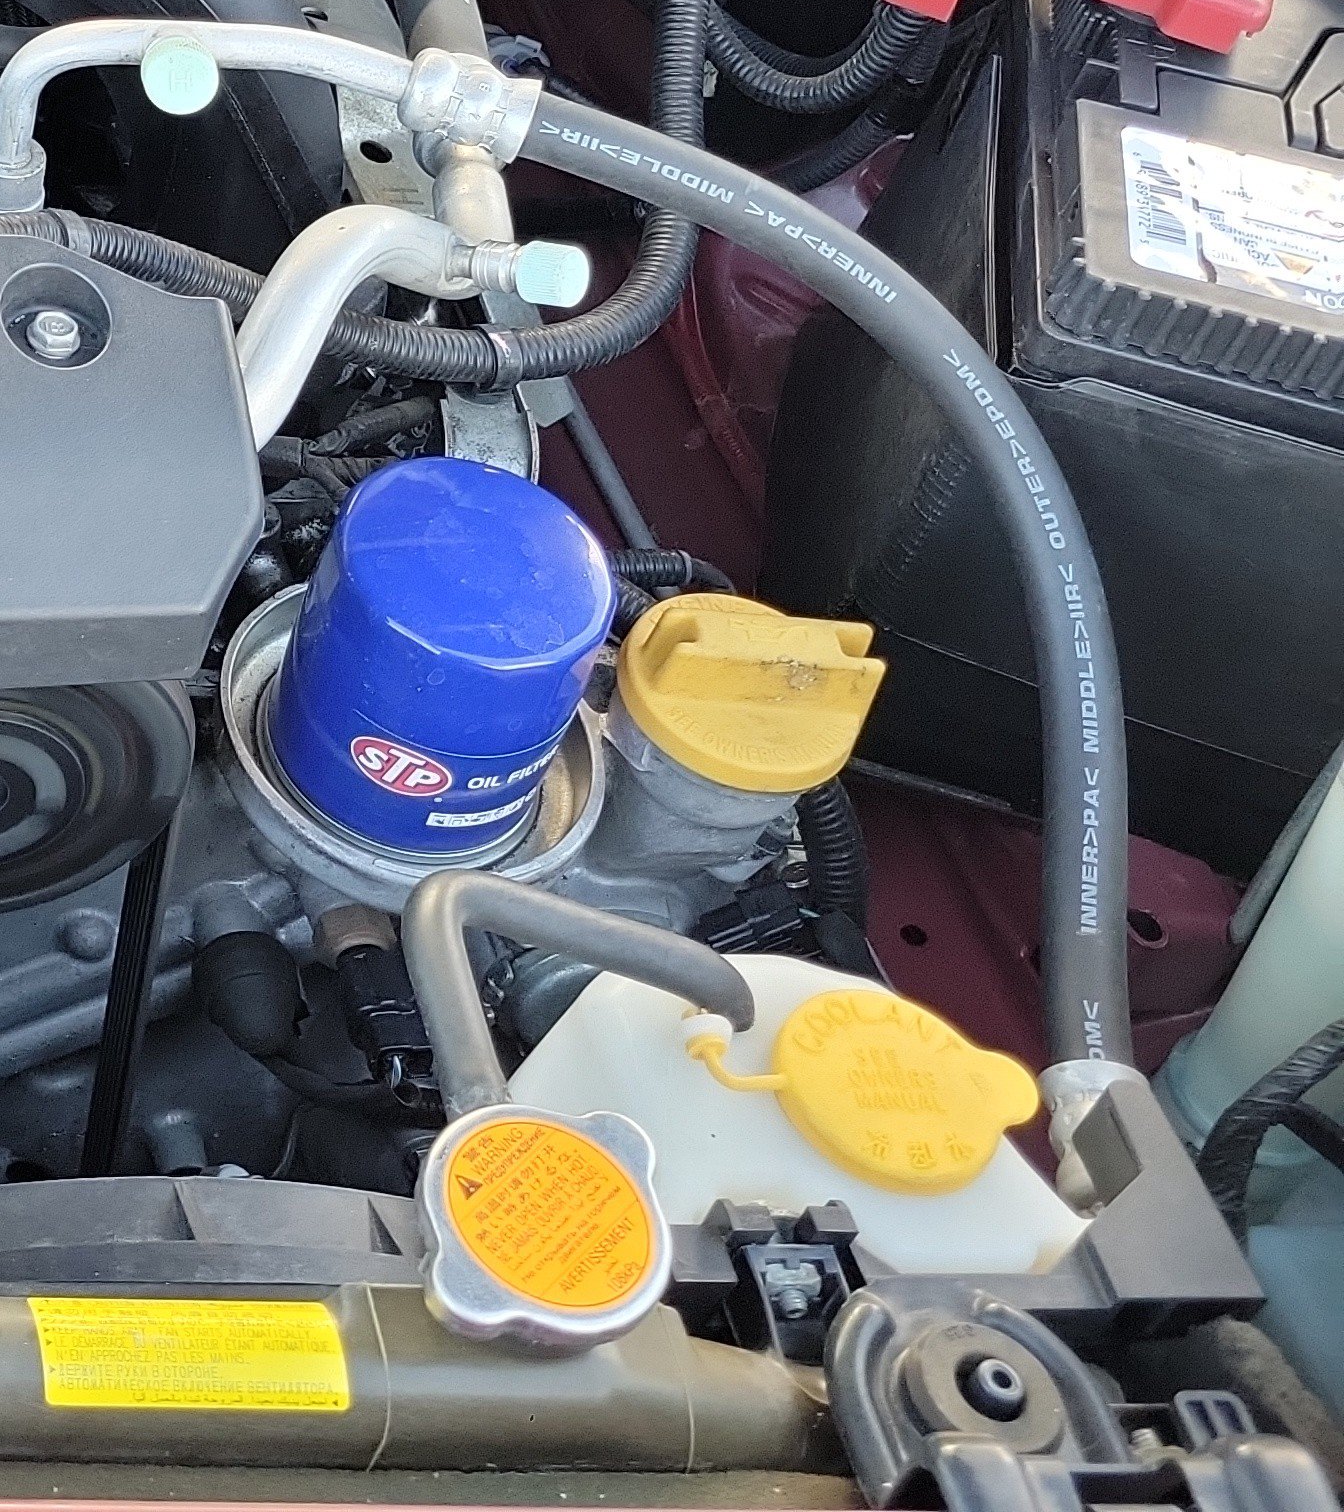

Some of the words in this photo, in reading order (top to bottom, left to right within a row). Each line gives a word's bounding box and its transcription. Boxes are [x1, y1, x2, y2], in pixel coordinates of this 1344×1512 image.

[538, 119, 736, 204] MIDDLE>IIR<
[744, 199, 898, 305] INNER>PA<
[942, 348, 1067, 551] OUTER>EPDM<
[1058, 562, 1101, 755] MIDDLE>IIR<
[357, 745, 443, 791] STP
[466, 776, 502, 790] OIL
[1080, 767, 1102, 937] INNER>PA<
[792, 996, 962, 1057] COOLANT
[470, 1126, 524, 1177] WARNING
[485, 1224, 517, 1255] NEVER
[516, 1201, 542, 1227] OPEN
[539, 1176, 570, 1204] WHEN
[567, 1152, 588, 1176] HOT
[535, 1195, 566, 1229] OUVRIR
[571, 1164, 601, 1194] CHAUD
[559, 1217, 635, 1293] AVERTISSEMENT
[55, 1348, 85, 1362] N'EN
[89, 1349, 151, 1364] APPROCHEZ
[156, 1350, 179, 1364] PAS
[183, 1351, 206, 1365] LES
[209, 1351, 252, 1365] MAINS.
[153, 1337, 219, 1351] VENTILATEUR
[158, 1327, 179, 1337] FAN
[185, 1327, 224, 1338] STARTS
